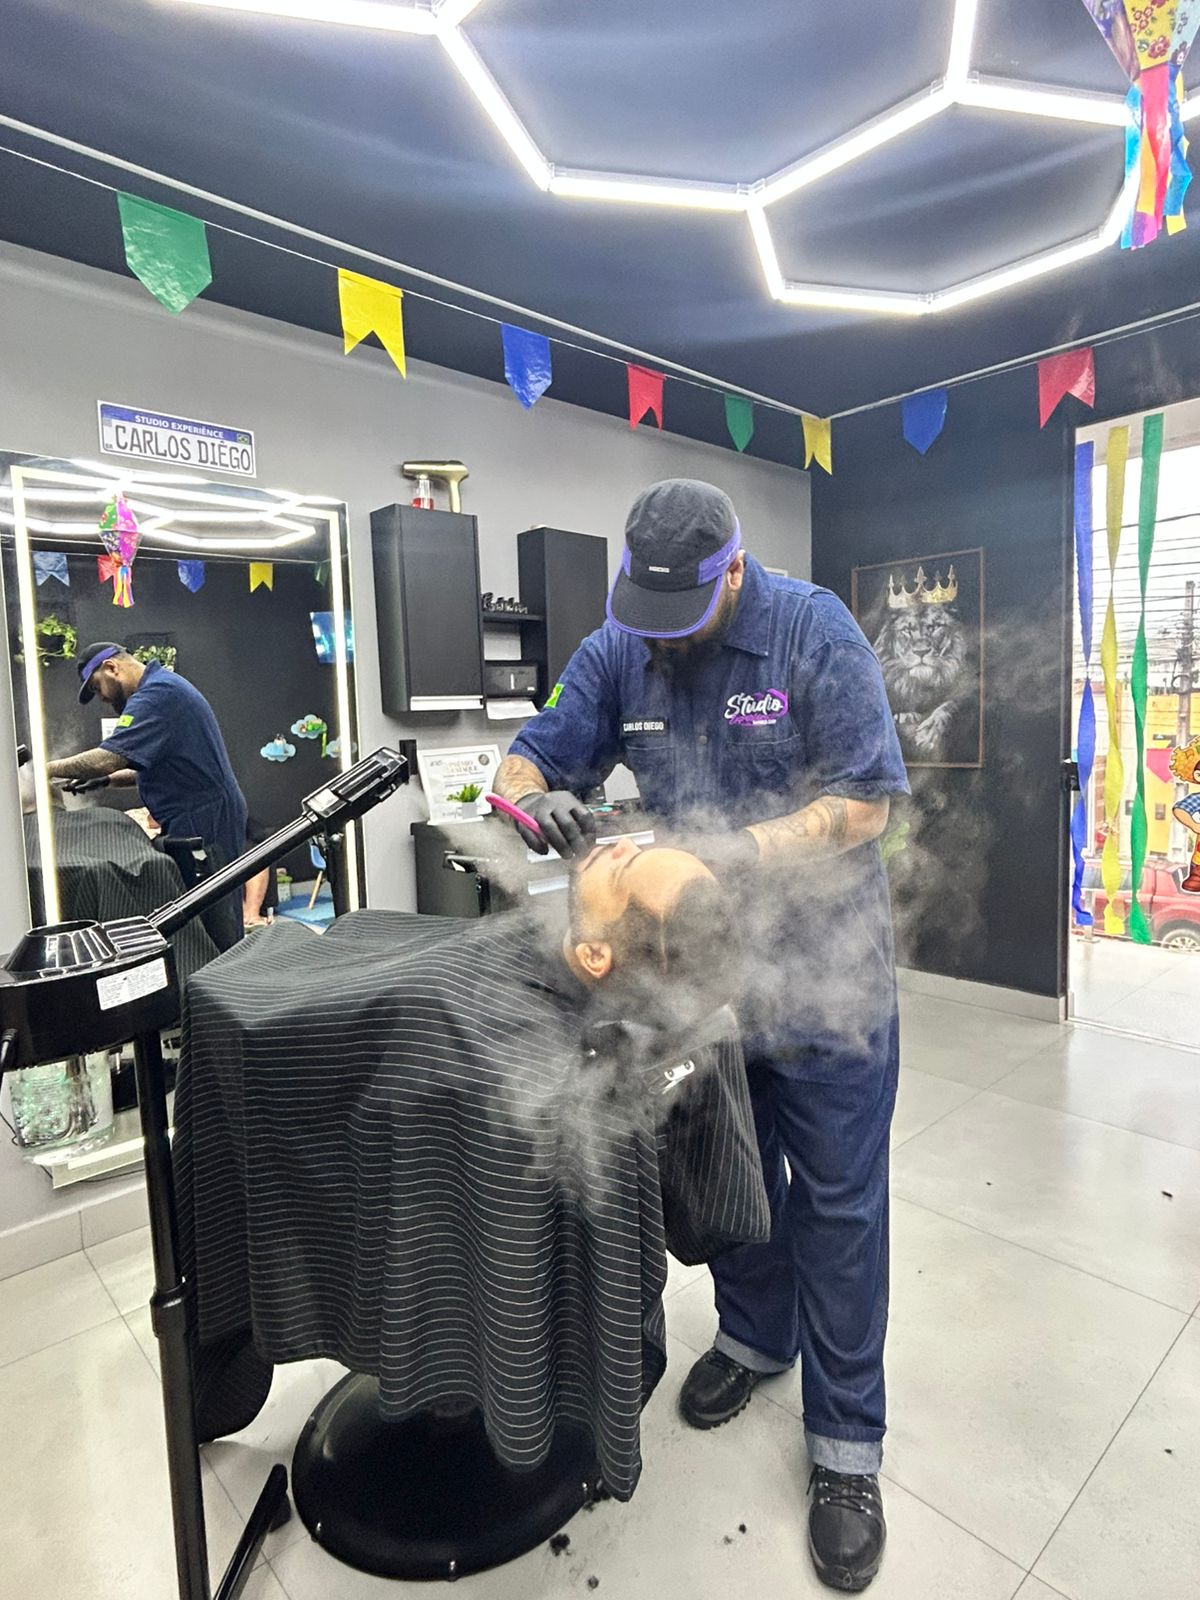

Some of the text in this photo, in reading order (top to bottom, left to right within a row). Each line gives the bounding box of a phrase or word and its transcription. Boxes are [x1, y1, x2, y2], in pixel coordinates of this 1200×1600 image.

[134, 414, 169, 428] STUDIO
[115, 424, 191, 461] CARLOS
[643, 721, 664, 731] DIEGO
